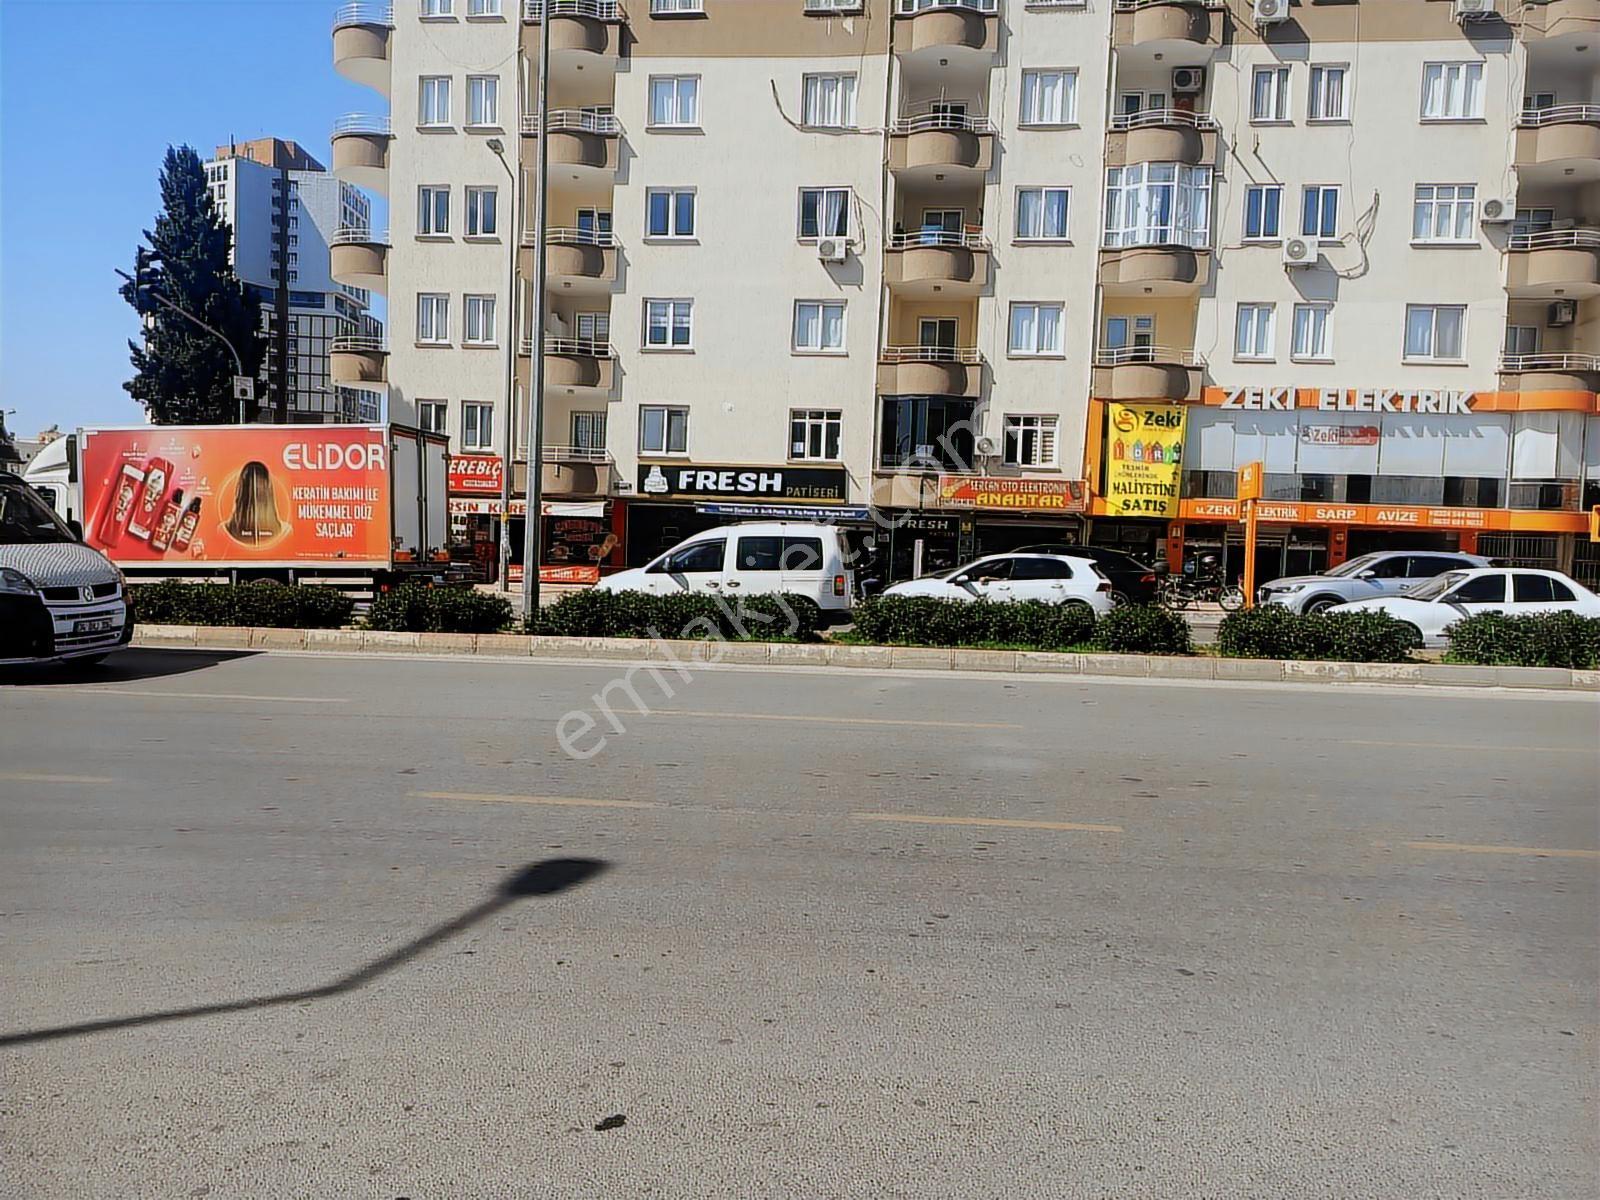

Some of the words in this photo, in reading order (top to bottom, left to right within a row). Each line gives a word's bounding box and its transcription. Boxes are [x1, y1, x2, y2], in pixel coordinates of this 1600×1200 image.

[1143, 410, 1181, 428] Zeki
[678, 470, 783, 493] FRESH
[1001, 481, 1018, 493] OTO
[976, 492, 1064, 508] ANAHTAR
[298, 502, 353, 520] MÜKEMMEL
[1316, 508, 1357, 520] SARP
